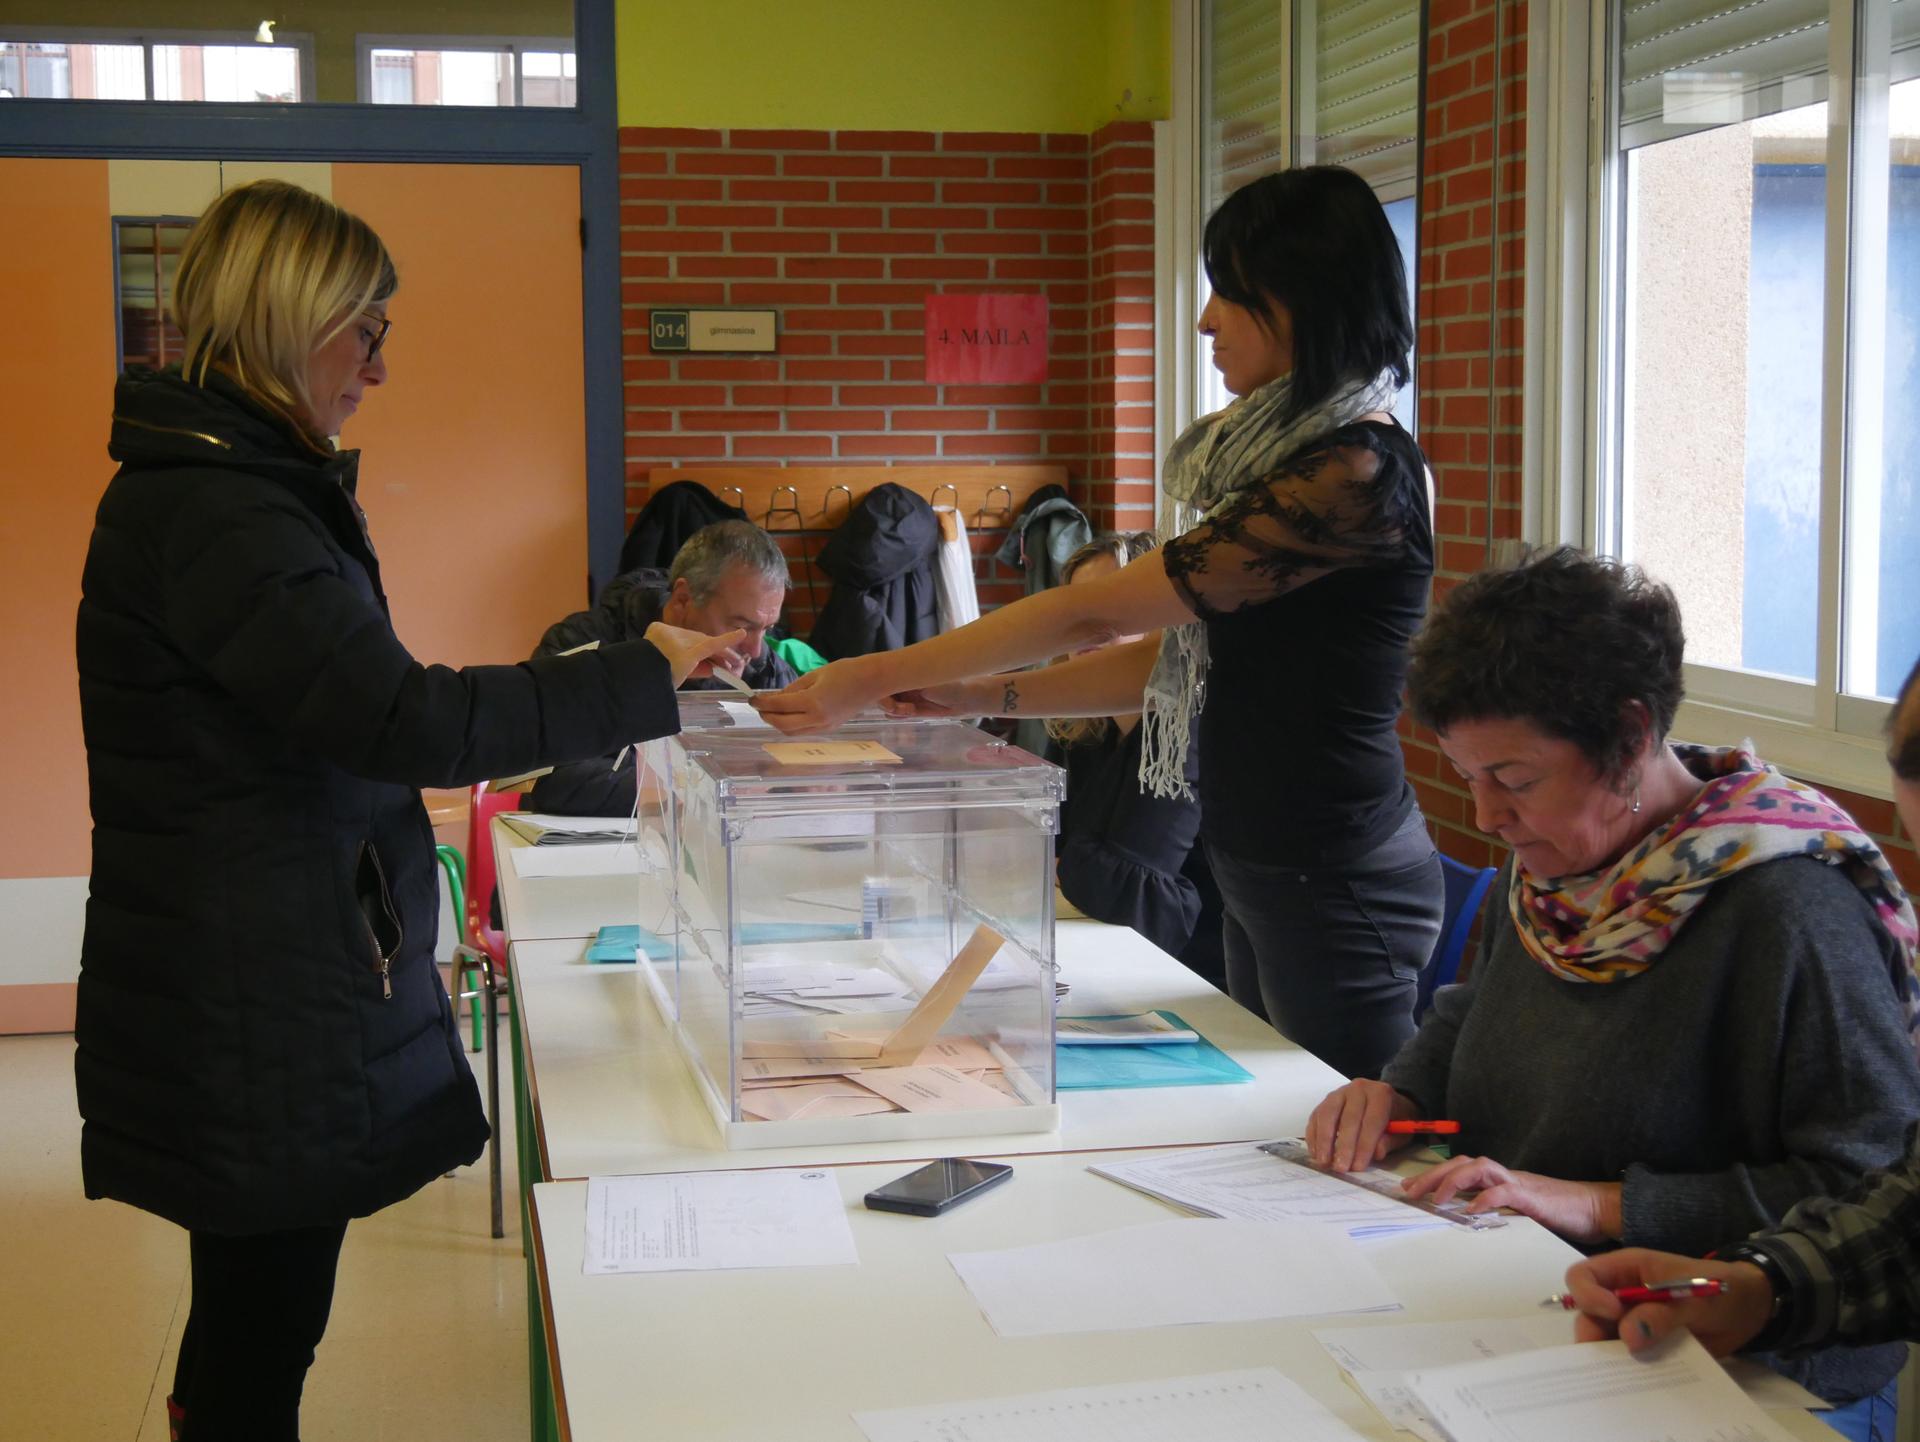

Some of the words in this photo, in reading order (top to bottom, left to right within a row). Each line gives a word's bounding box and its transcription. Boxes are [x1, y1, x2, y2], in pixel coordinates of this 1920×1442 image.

[655, 323, 686, 338] 014
[938, 328, 955, 345] 4.
[961, 328, 1031, 345] MAILA
